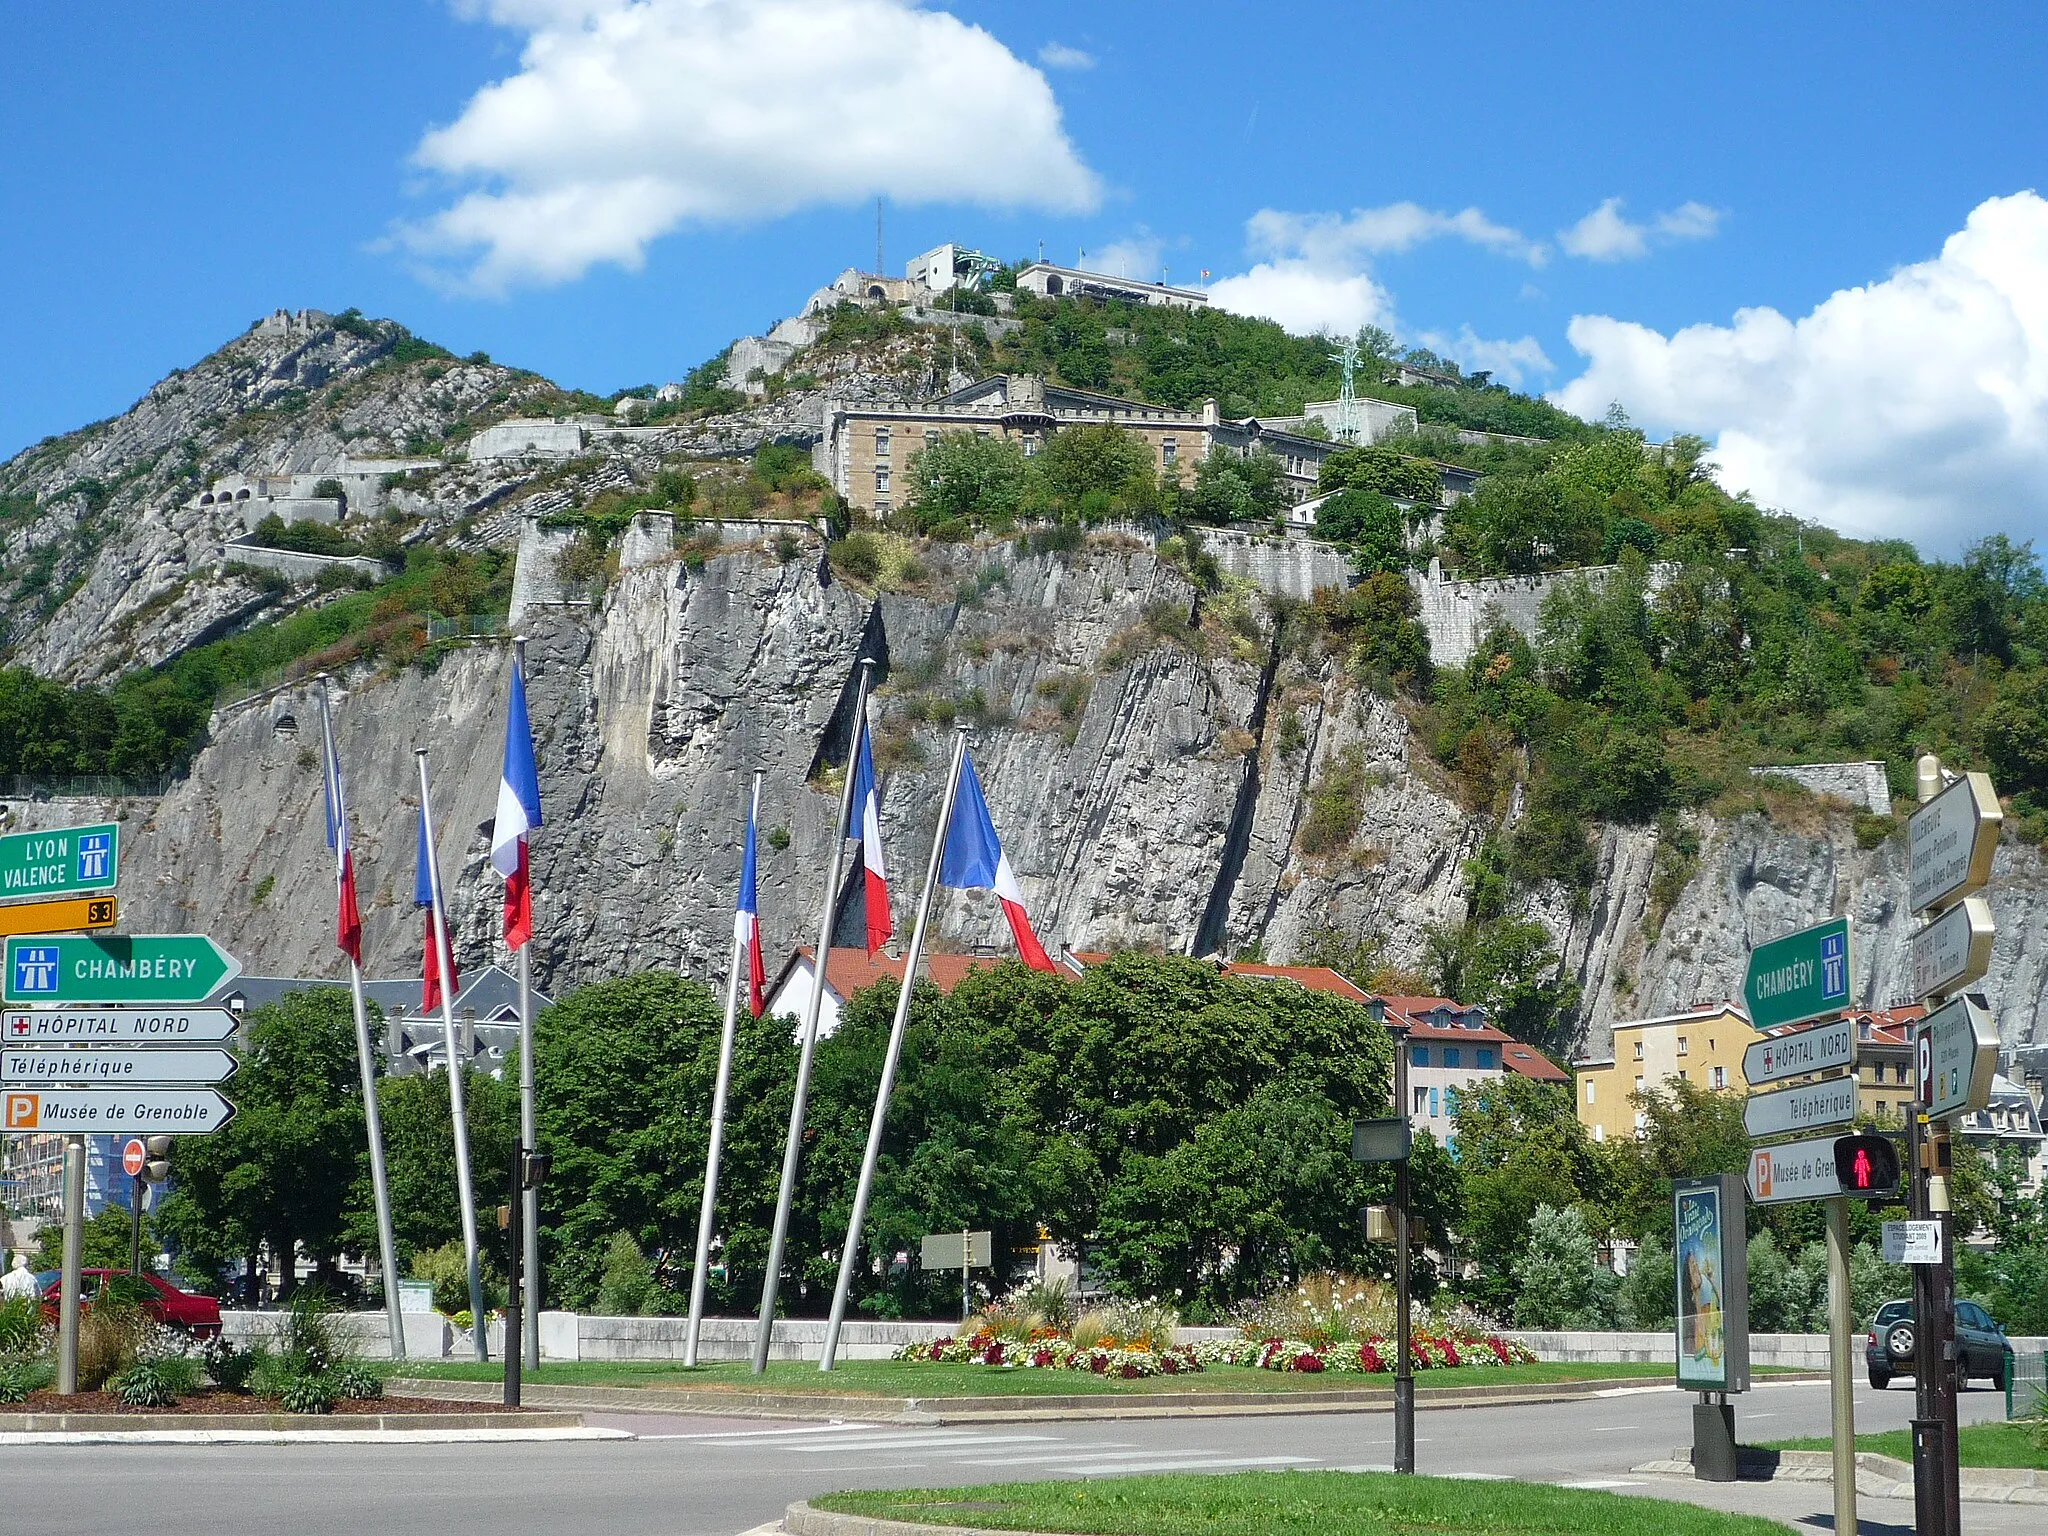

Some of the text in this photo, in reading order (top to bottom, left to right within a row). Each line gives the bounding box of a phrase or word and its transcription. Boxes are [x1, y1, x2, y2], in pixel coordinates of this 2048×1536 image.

[26, 838, 68, 861] LYON
[4, 864, 66, 888] VALENCE
[75, 954, 197, 978] CHAMBÉRY
[1756, 957, 1814, 1000] CHAMBÉRY
[37, 1015, 189, 1033] HÔPITAL NORD
[1776, 1033, 1848, 1069] HÔPITAL NORD
[11, 1058, 133, 1077] Téléphérique
[43, 1104, 97, 1119] Musée
[106, 1104, 125, 1119] de
[134, 1104, 208, 1119] Grenoble
[1790, 1093, 1851, 1121] Téléphérique
[1773, 1162, 1799, 1184] Musée
[1802, 1159, 1812, 1180] de
[1815, 1157, 1835, 1178] Gren
